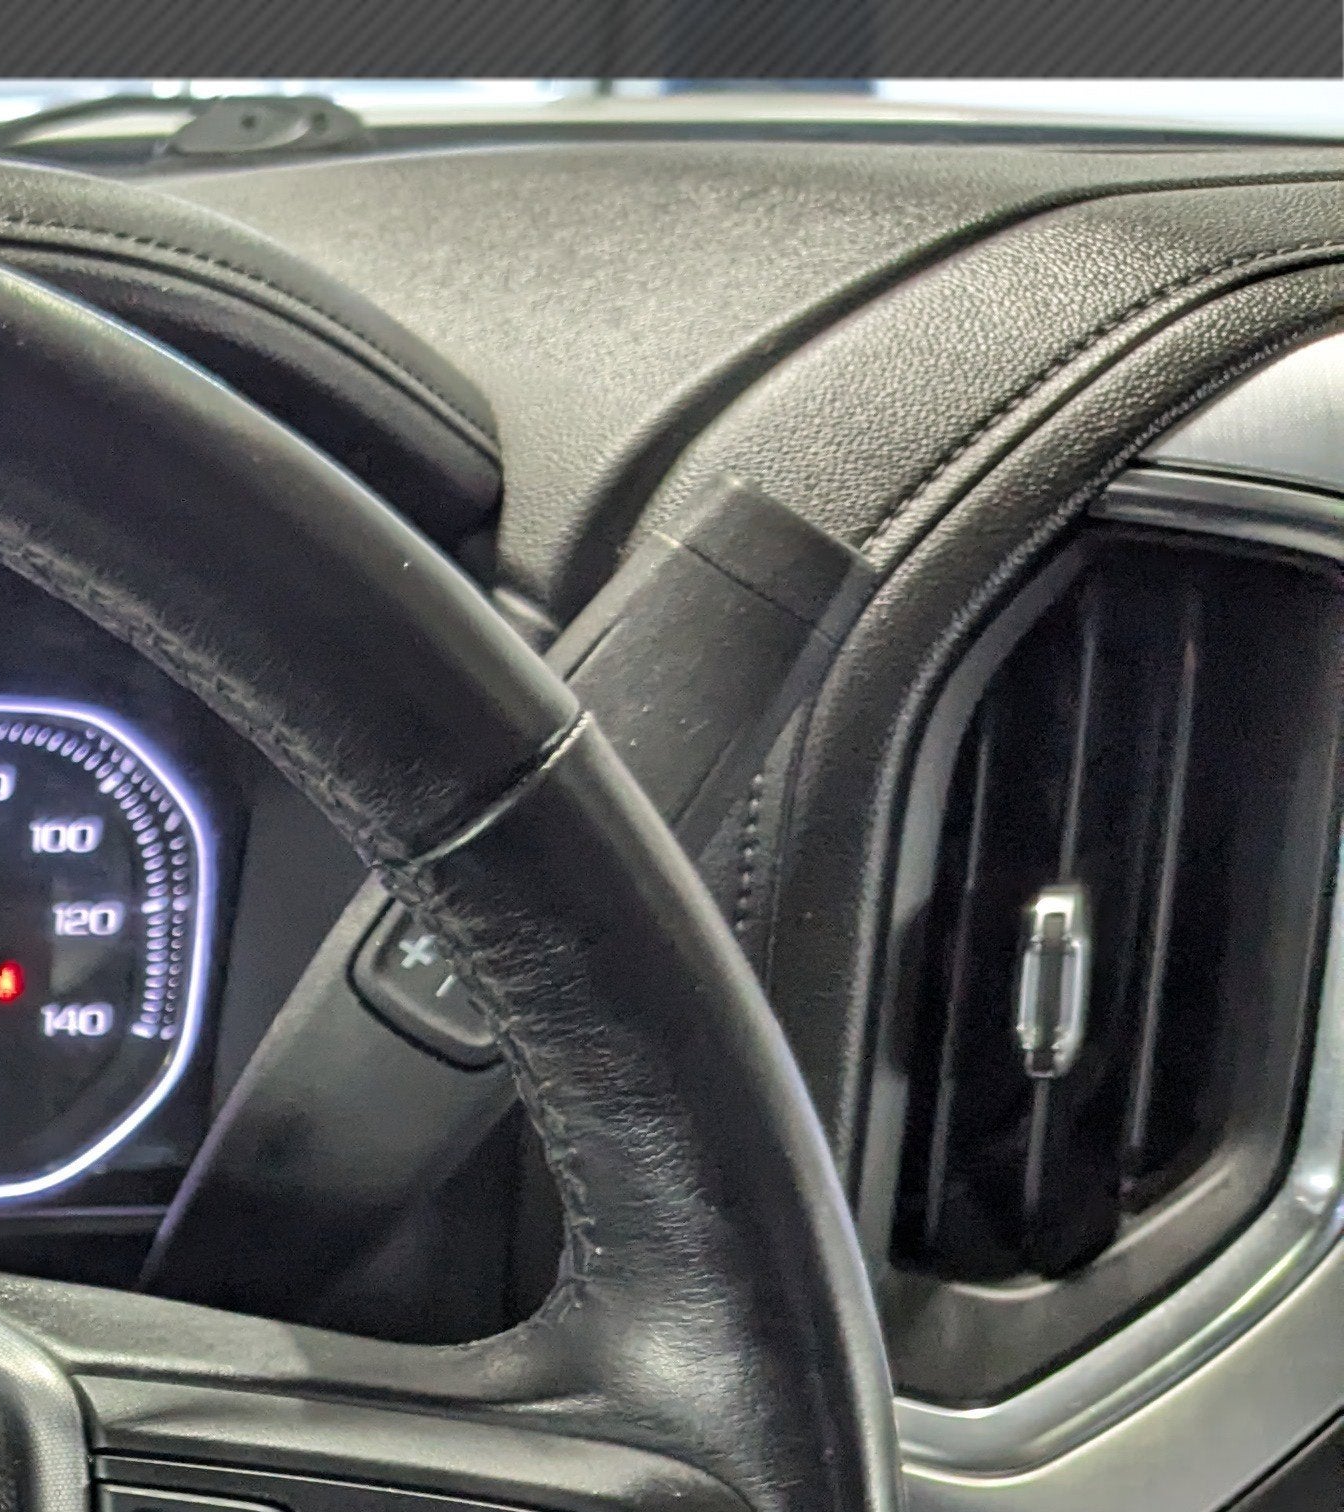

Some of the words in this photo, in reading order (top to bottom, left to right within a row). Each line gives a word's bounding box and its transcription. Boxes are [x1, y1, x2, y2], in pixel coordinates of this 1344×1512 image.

[29, 816, 103, 853] 100
[53, 901, 123, 936] 120
[40, 1003, 112, 1037] 140
